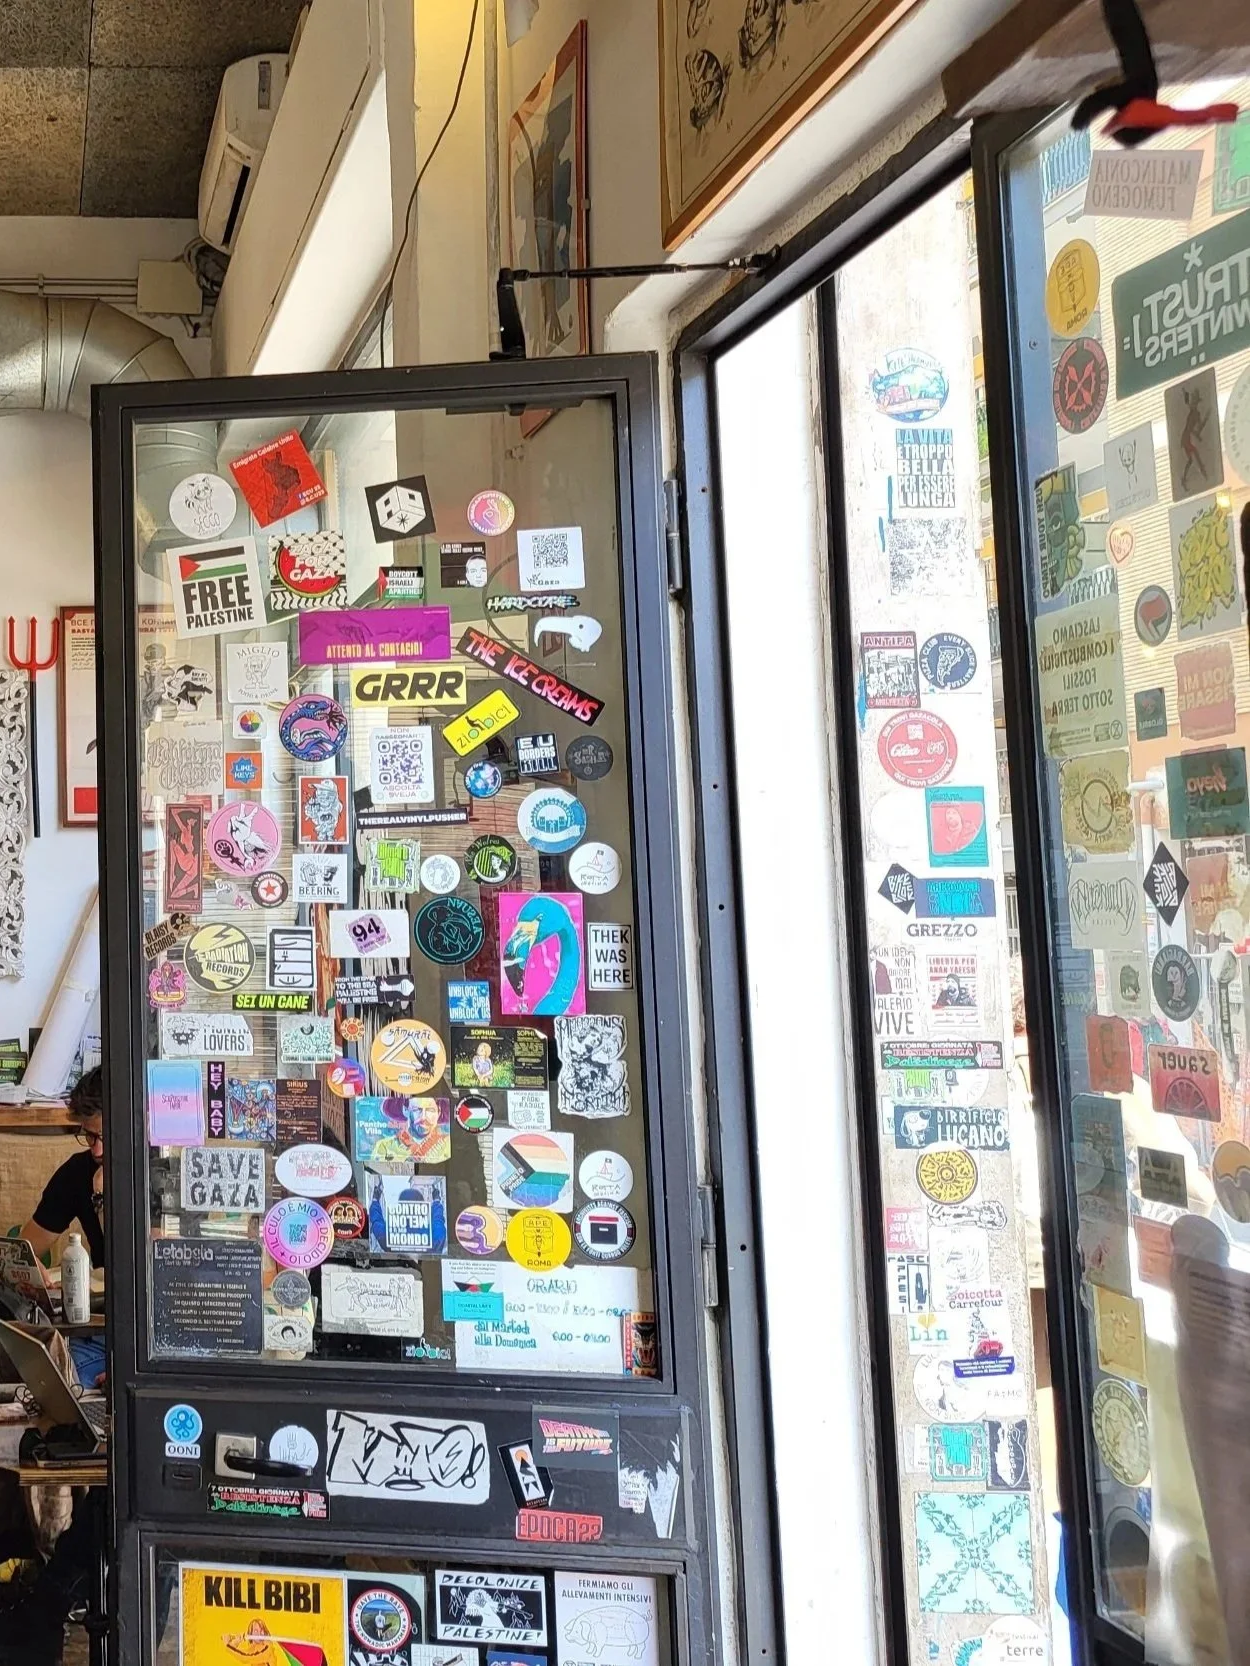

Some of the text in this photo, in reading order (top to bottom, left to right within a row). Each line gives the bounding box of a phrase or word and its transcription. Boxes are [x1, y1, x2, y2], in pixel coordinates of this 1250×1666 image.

[896, 429, 953, 444] LA VITA
[905, 444, 953, 460] TROPPO
[898, 460, 954, 476] BELLA
[899, 475, 955, 492] PER ESSERE
[899, 491, 956, 508] LUNGA
[193, 513, 221, 530] SECCO
[295, 553, 330, 568] FOR
[289, 567, 336, 583] GAZA
[388, 570, 418, 578] BOYCOTT
[182, 575, 253, 615] FREE
[487, 595, 580, 611] HARDCORE
[187, 606, 255, 630] PALESTINE
[864, 635, 915, 647] ANTIFA
[922, 637, 938, 655] CLUB
[943, 635, 967, 648] EVERY
[236, 646, 280, 660] MIGLIO
[326, 641, 423, 658] ATTENTO AL CONTAGIO!
[921, 656, 934, 680] PIZZA
[465, 631, 599, 721] THE ICE CREAMS
[355, 671, 464, 701] GRRR
[518, 746, 556, 761] BORDERS
[234, 770, 256, 779] KEYS
[235, 763, 254, 772] LIKE
[382, 784, 422, 792] ASCOLTA
[358, 812, 467, 826] THEREALVINYLPUSHER
[298, 886, 340, 896] BEERING
[145, 924, 169, 943] BLAISY
[352, 918, 381, 942] 94
[592, 930, 629, 945] THEK
[906, 923, 978, 938] GREZZO
[145, 934, 177, 958] RECORDS
[595, 949, 627, 964] WAS
[962, 957, 976, 966] PER
[206, 962, 246, 978] RECORDS
[593, 968, 631, 984] HERE
[335, 988, 378, 998] PALESTINE
[336, 981, 377, 990] TO THE SEA
[448, 985, 478, 998] UNBLOCK
[235, 994, 310, 1010] SEI UN CANE
[874, 997, 913, 1011] ALERIO
[449, 1007, 491, 1020] UNBLOCK US
[875, 1011, 915, 1035] VIVE
[203, 1034, 246, 1052] LOVERS
[210, 1064, 223, 1136] HEY BABY
[359, 1120, 388, 1128] Pancho
[365, 1127, 382, 1135] Villa
[937, 1124, 1005, 1147] LUCANO
[191, 1152, 261, 1179] SAVE
[190, 1183, 260, 1208] GAZA
[388, 1203, 428, 1215] CONTRO
[268, 1202, 329, 1265] IL CULO MIO E DECIDO IO
[389, 1233, 429, 1246] MONDO
[949, 1299, 1003, 1310] Carrefour
[495, 1335, 537, 1349] Domenica
[167, 1445, 198, 1456] OONI
[258, 1488, 300, 1496] GIORNATA
[441, 1573, 541, 1591] DECOLONIZE
[578, 1579, 634, 1591] FERMIAMO GLI
[204, 1575, 321, 1614] KILL BIBI
[561, 1589, 652, 1603] ALLEVAMENTI INTENSIVI
[356, 1592, 404, 1613] DAVE THE RAVE
[442, 1626, 542, 1642] PALESTINE!
[1006, 1644, 1044, 1657] terre
